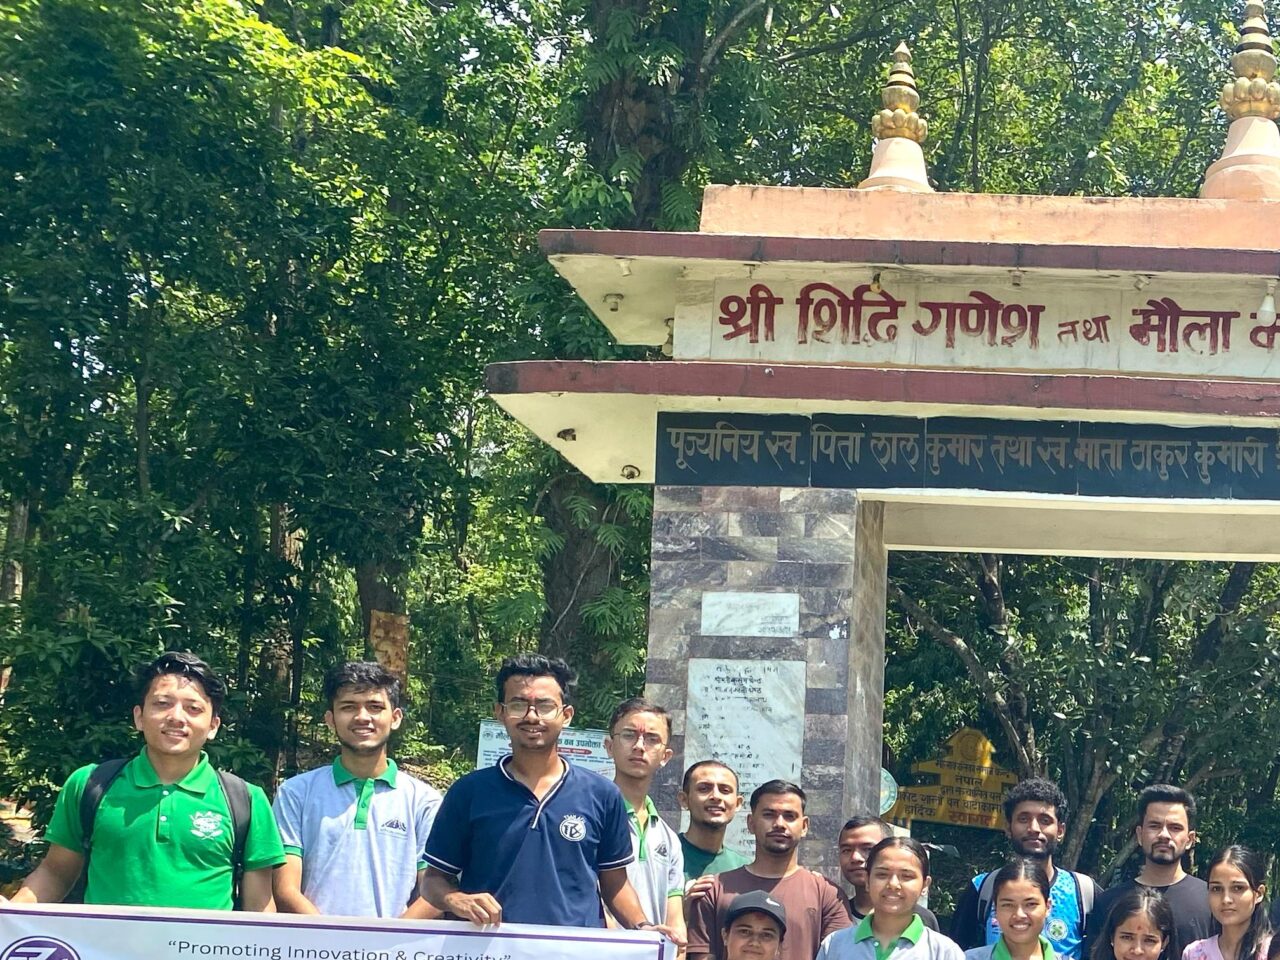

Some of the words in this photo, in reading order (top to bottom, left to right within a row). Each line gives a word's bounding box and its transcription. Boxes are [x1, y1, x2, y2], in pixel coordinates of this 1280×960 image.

[719, 283, 784, 343] श्री
[912, 290, 1046, 350] गणेश
[1056, 314, 1112, 345] तथा
[1129, 297, 1240, 355] मौला
[810, 423, 865, 471] पिता
[870, 433, 920, 473] लाल
[925, 434, 987, 475] कुमार
[990, 435, 1036, 475] तथा
[1074, 437, 1127, 479] माता
[1130, 440, 1191, 481] ठाकुर
[168, 940, 281, 960] “Promoting
